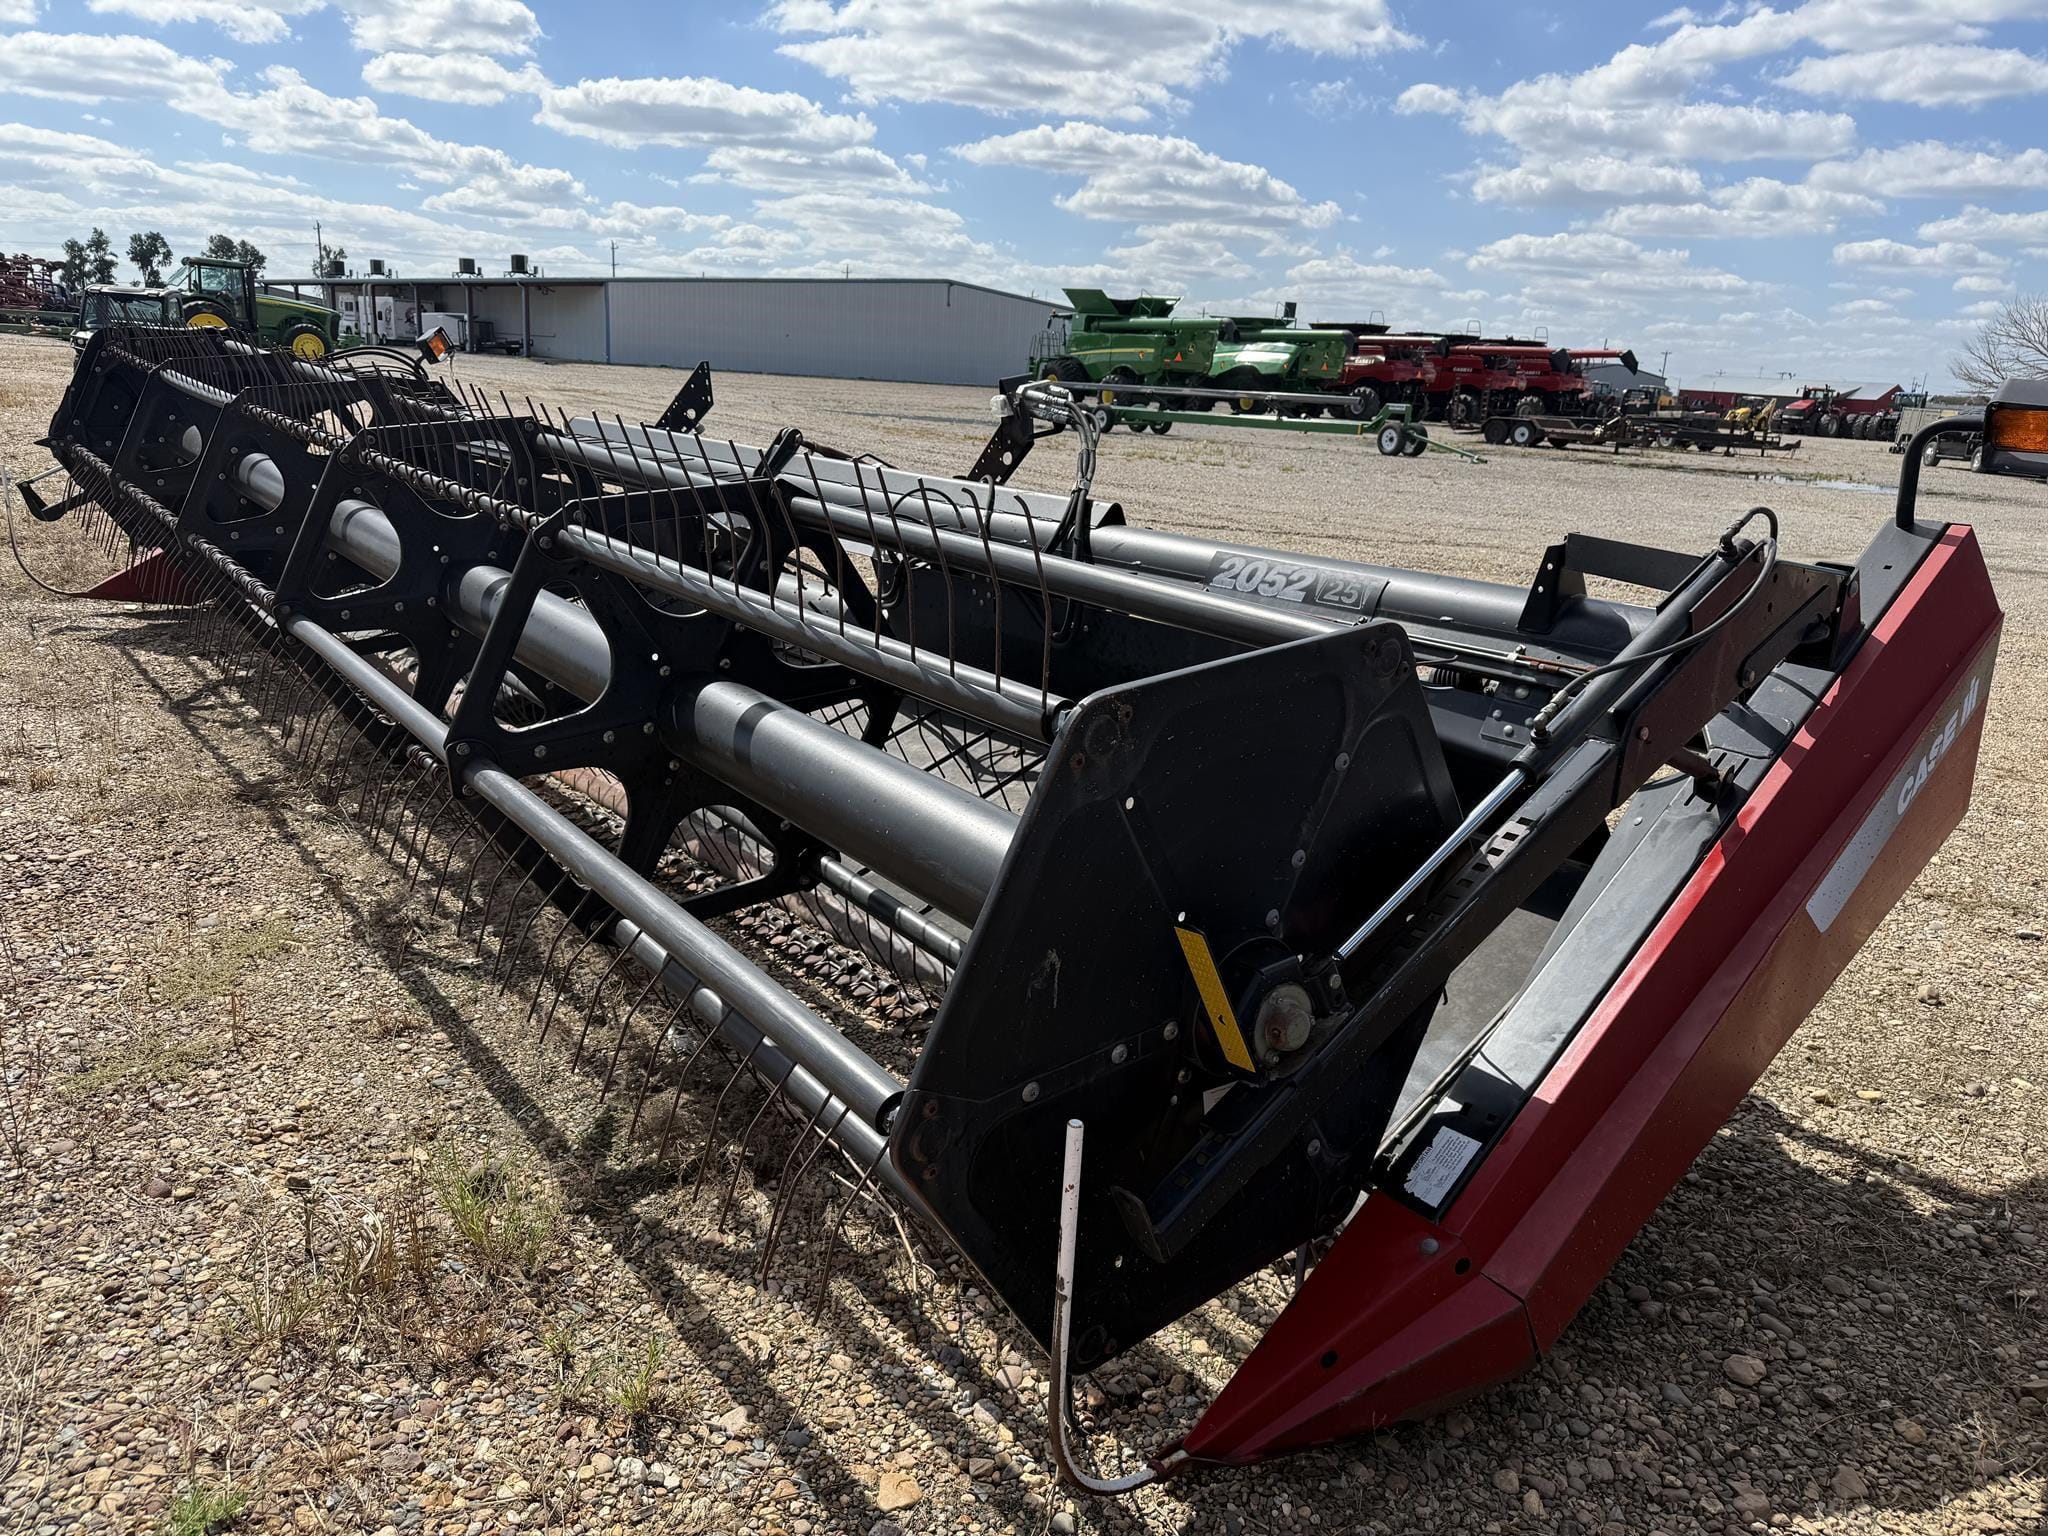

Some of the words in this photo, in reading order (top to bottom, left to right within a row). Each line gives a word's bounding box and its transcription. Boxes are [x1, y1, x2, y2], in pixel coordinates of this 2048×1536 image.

[1210, 557, 1316, 602] 2052
[1323, 581, 1362, 604] 25
[1897, 709, 1959, 816] CASE
[1412, 1147, 1432, 1172] IMPORTAN
